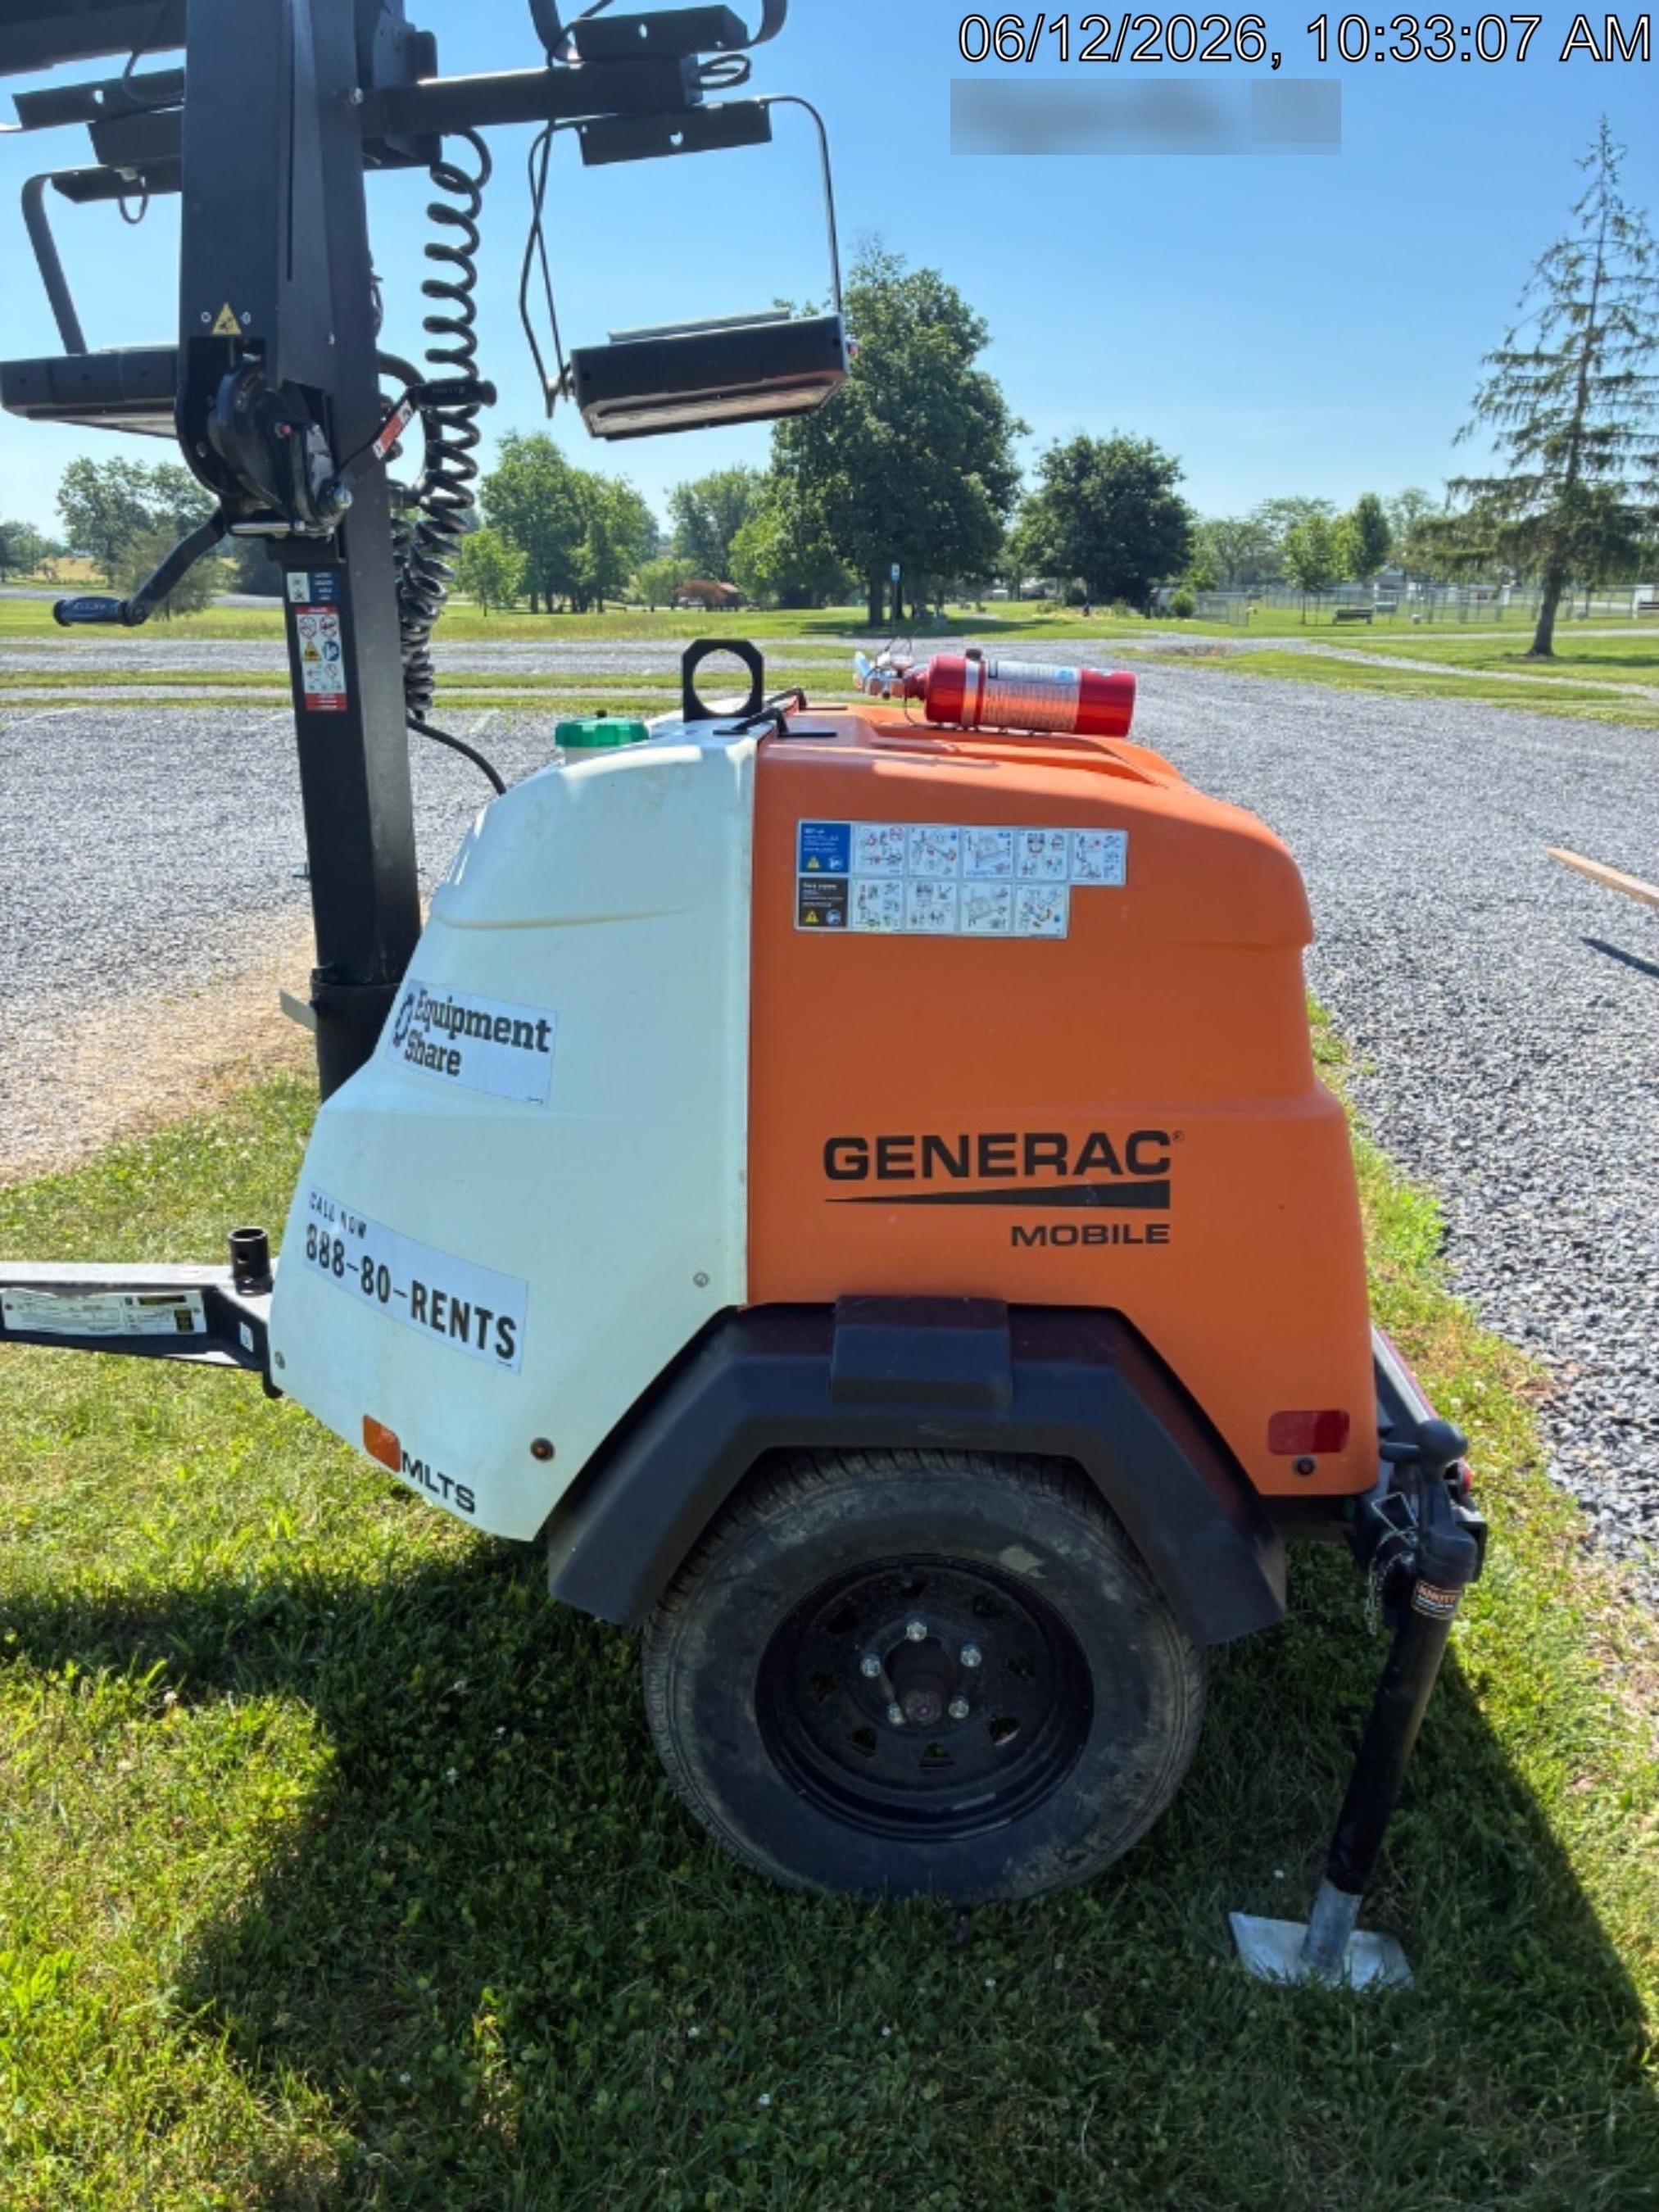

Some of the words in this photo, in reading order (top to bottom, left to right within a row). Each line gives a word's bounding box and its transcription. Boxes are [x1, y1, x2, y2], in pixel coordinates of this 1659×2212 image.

[415, 988, 552, 1053] Equipment
[404, 1029, 461, 1077] Share
[823, 1130, 1172, 1181] GENERAC
[310, 1191, 335, 1222] CALL
[340, 1211, 367, 1240] NOW
[1011, 1223, 1170, 1247] MOBILE
[306, 1223, 517, 1361] 888-80-RENTS
[401, 1449, 476, 1515] MLTS
